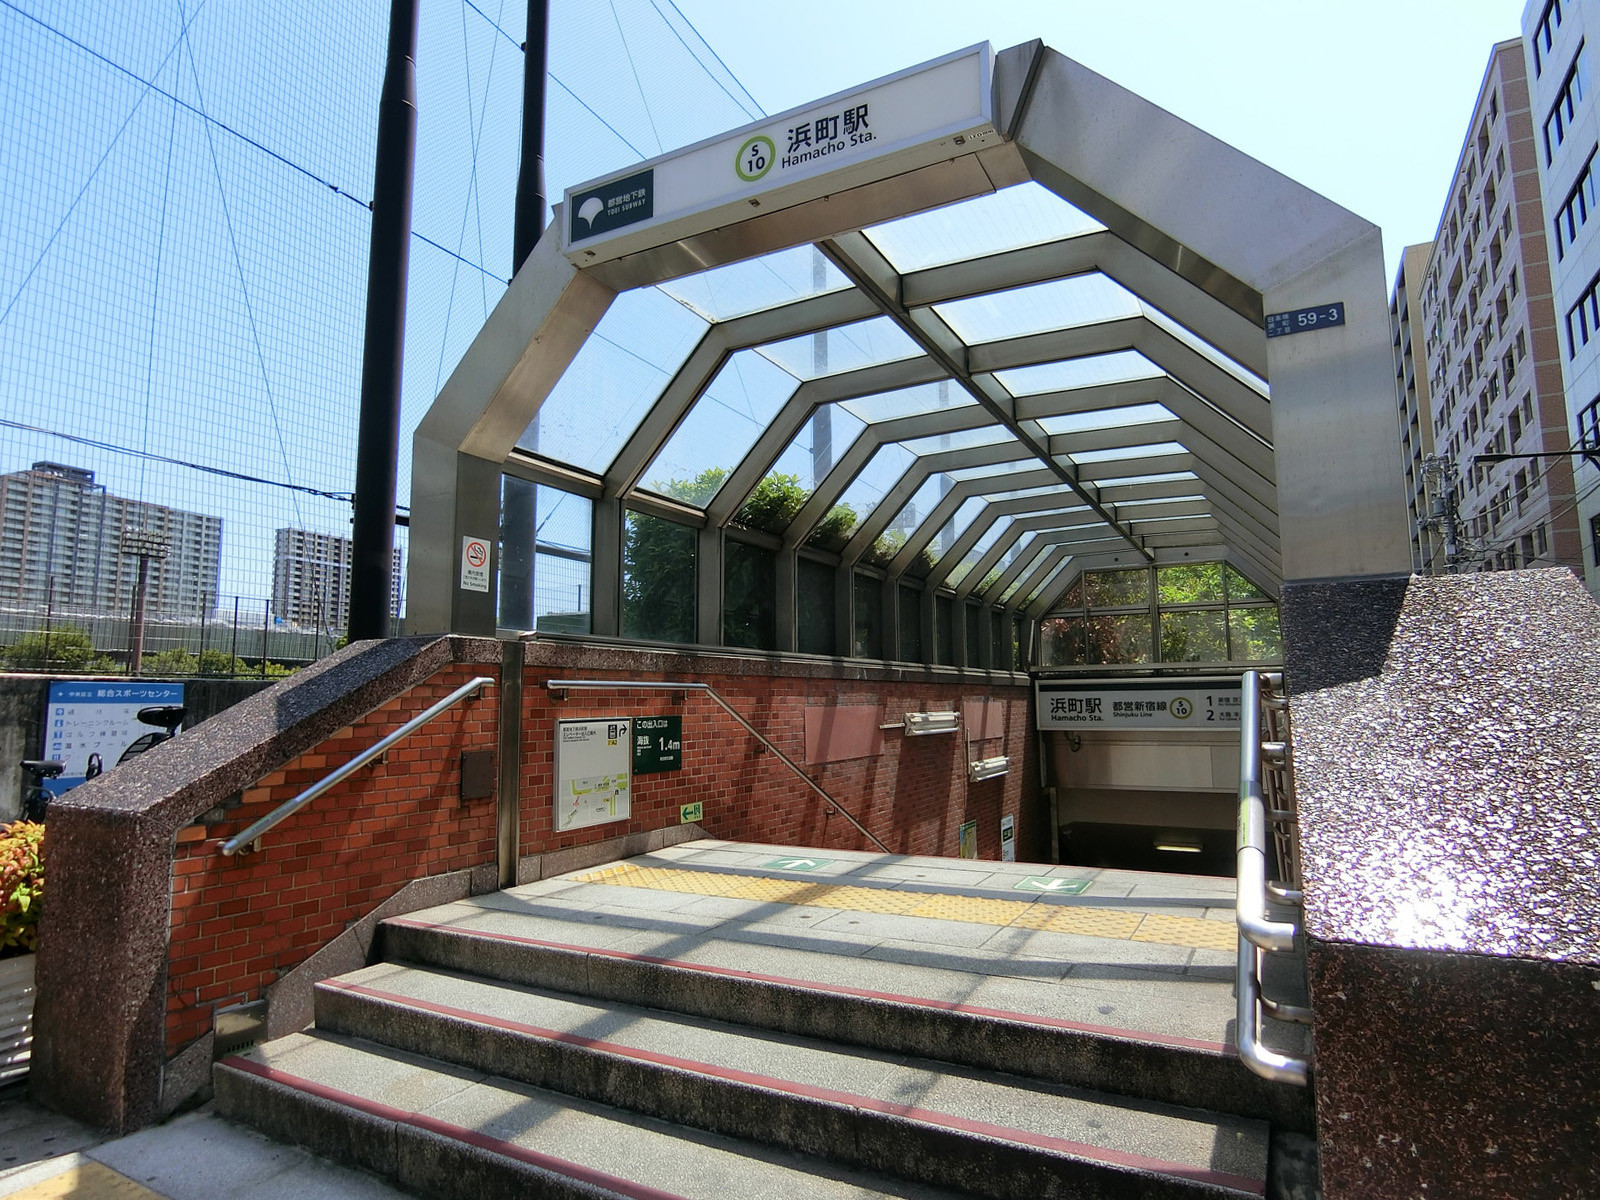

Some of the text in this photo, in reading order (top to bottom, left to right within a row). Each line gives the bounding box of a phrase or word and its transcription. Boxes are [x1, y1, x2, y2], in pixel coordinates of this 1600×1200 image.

[788, 104, 869, 153] 浜町駅
[751, 144, 759, 157] S
[782, 132, 877, 169] Hamacho Sta.
[748, 156, 765, 172] 10
[607, 199, 646, 216] TOEI SUBWAY
[1298, 308, 1338, 326] 59-3
[97, 689, 178, 698] 総合スポーツセンター
[1206, 695, 1213, 706] 1
[1050, 697, 1102, 714] 浜町駅
[1112, 701, 1168, 711] 都営新宿線
[1051, 714, 1104, 722] Hamacho Sta.
[1206, 710, 1215, 721] 2
[637, 720, 668, 729] この出入口は
[659, 736, 681, 751] 1.4m
